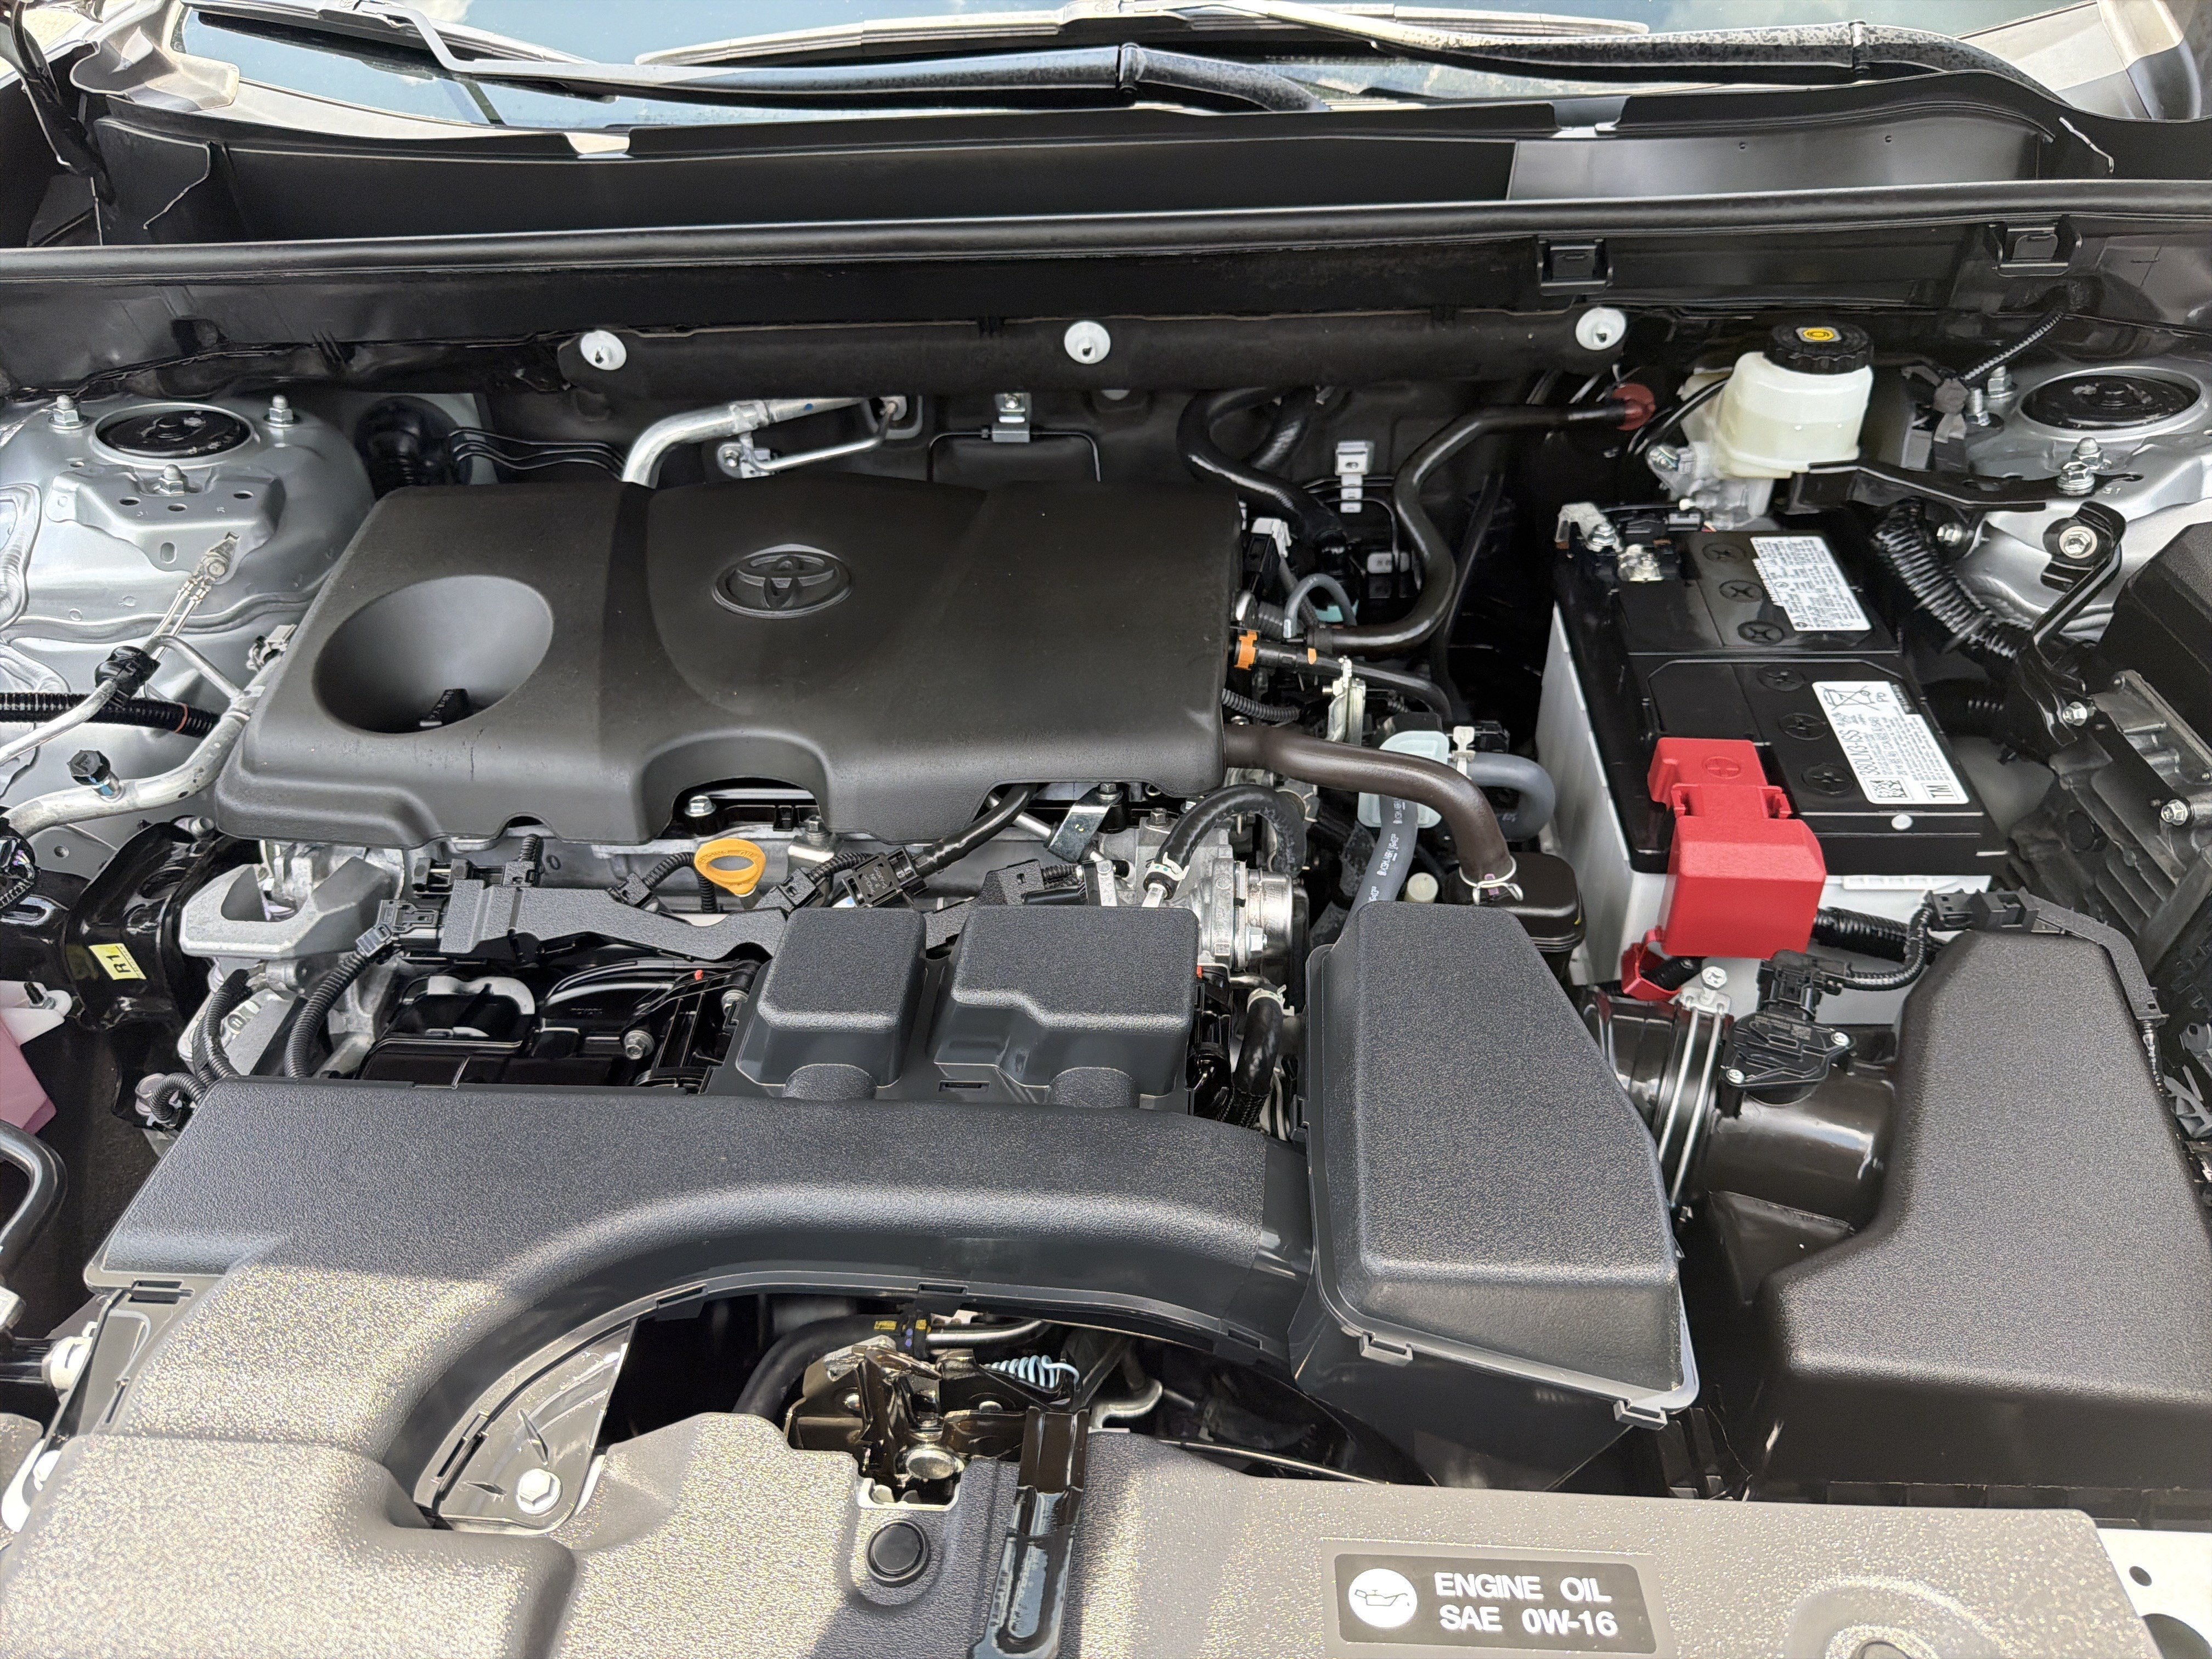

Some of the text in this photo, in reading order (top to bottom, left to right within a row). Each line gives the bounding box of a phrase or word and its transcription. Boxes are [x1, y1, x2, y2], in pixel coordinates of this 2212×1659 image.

[1838, 729, 1880, 776] 380LN3-ISS
[1926, 785, 1955, 799] TM
[105, 955, 132, 973] R1
[1434, 1572, 1612, 1603] ENGINE OIL
[1439, 1604, 1618, 1637] SAE 0W-16
